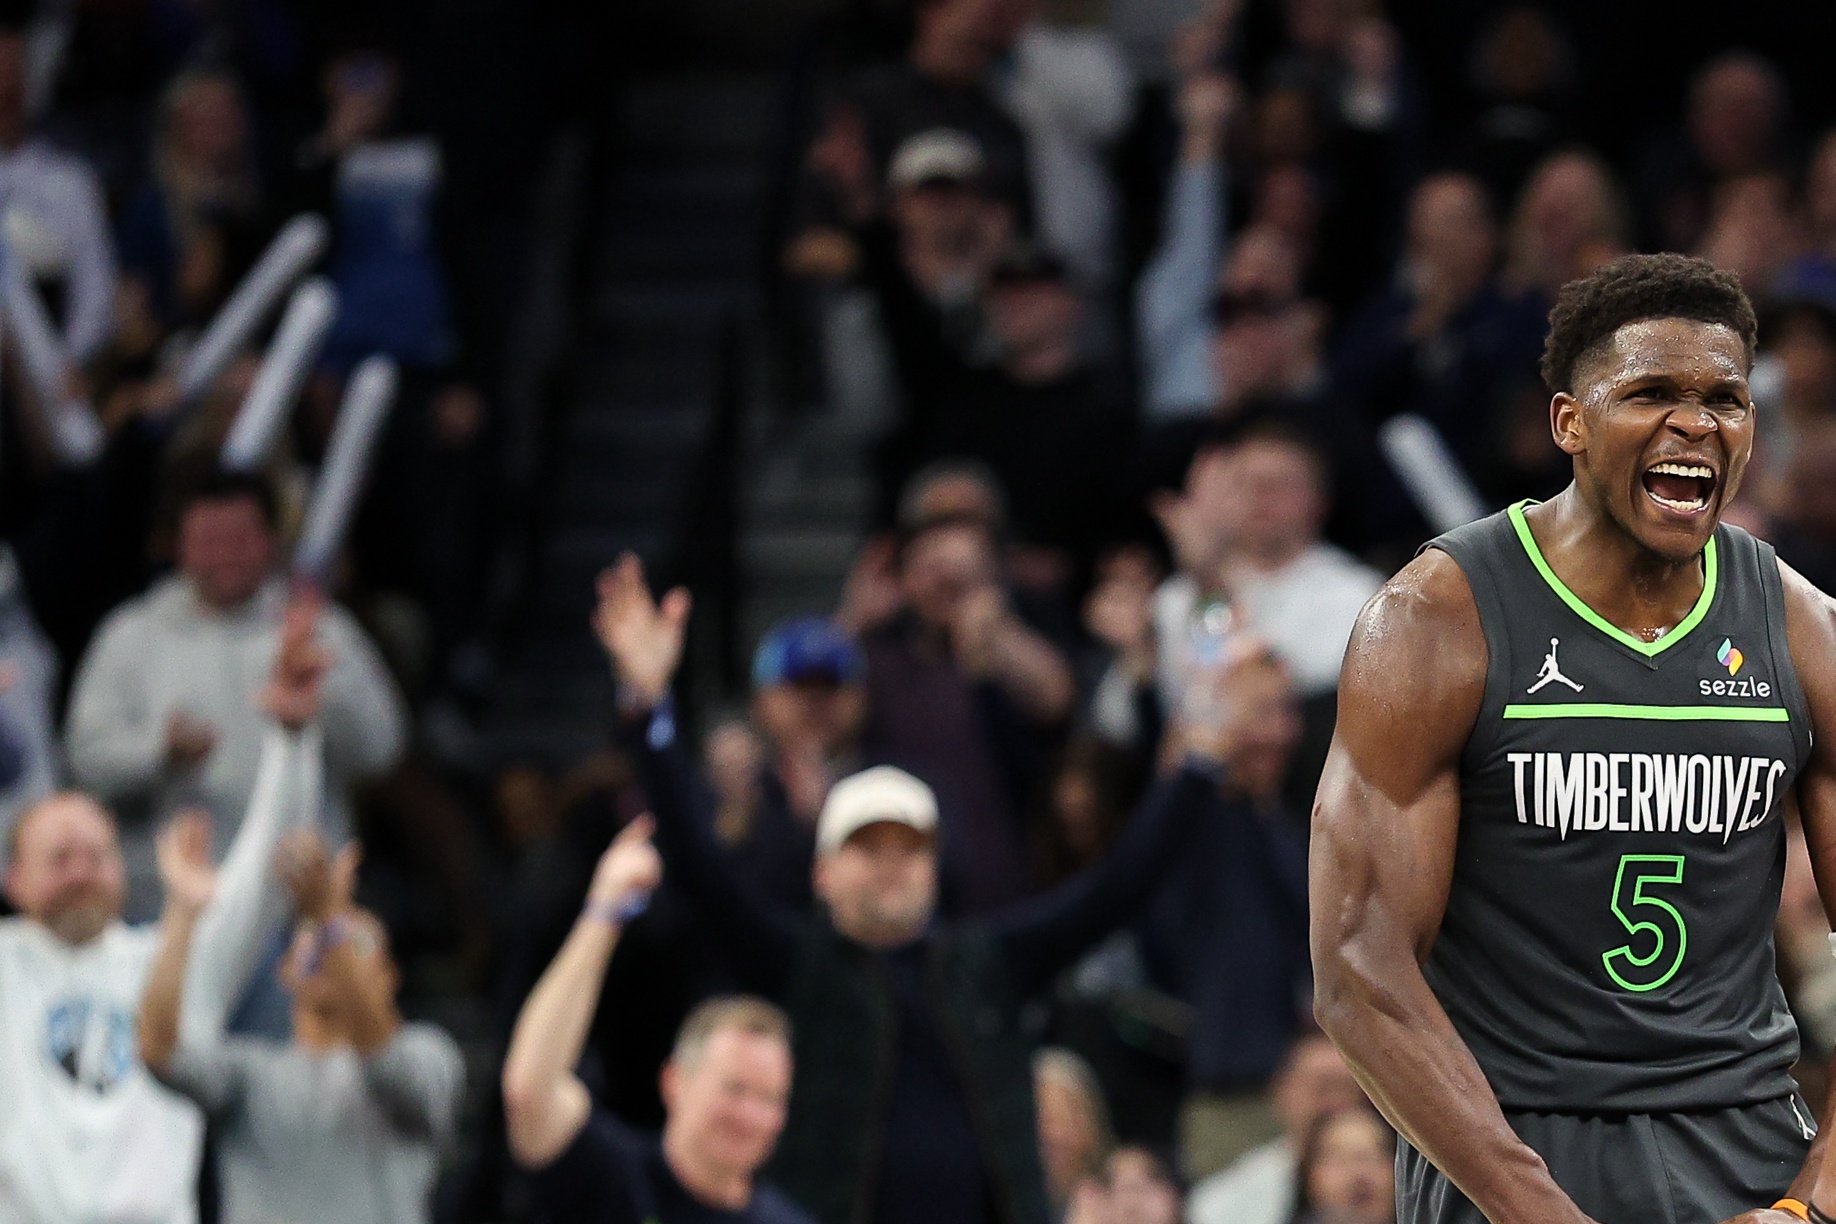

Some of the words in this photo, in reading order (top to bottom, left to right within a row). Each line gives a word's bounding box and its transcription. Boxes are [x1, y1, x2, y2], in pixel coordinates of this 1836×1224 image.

[1699, 675, 1771, 698] sezzle
[1506, 752, 1787, 845] TIMBERWOLVES
[1602, 855, 1687, 992] 5
